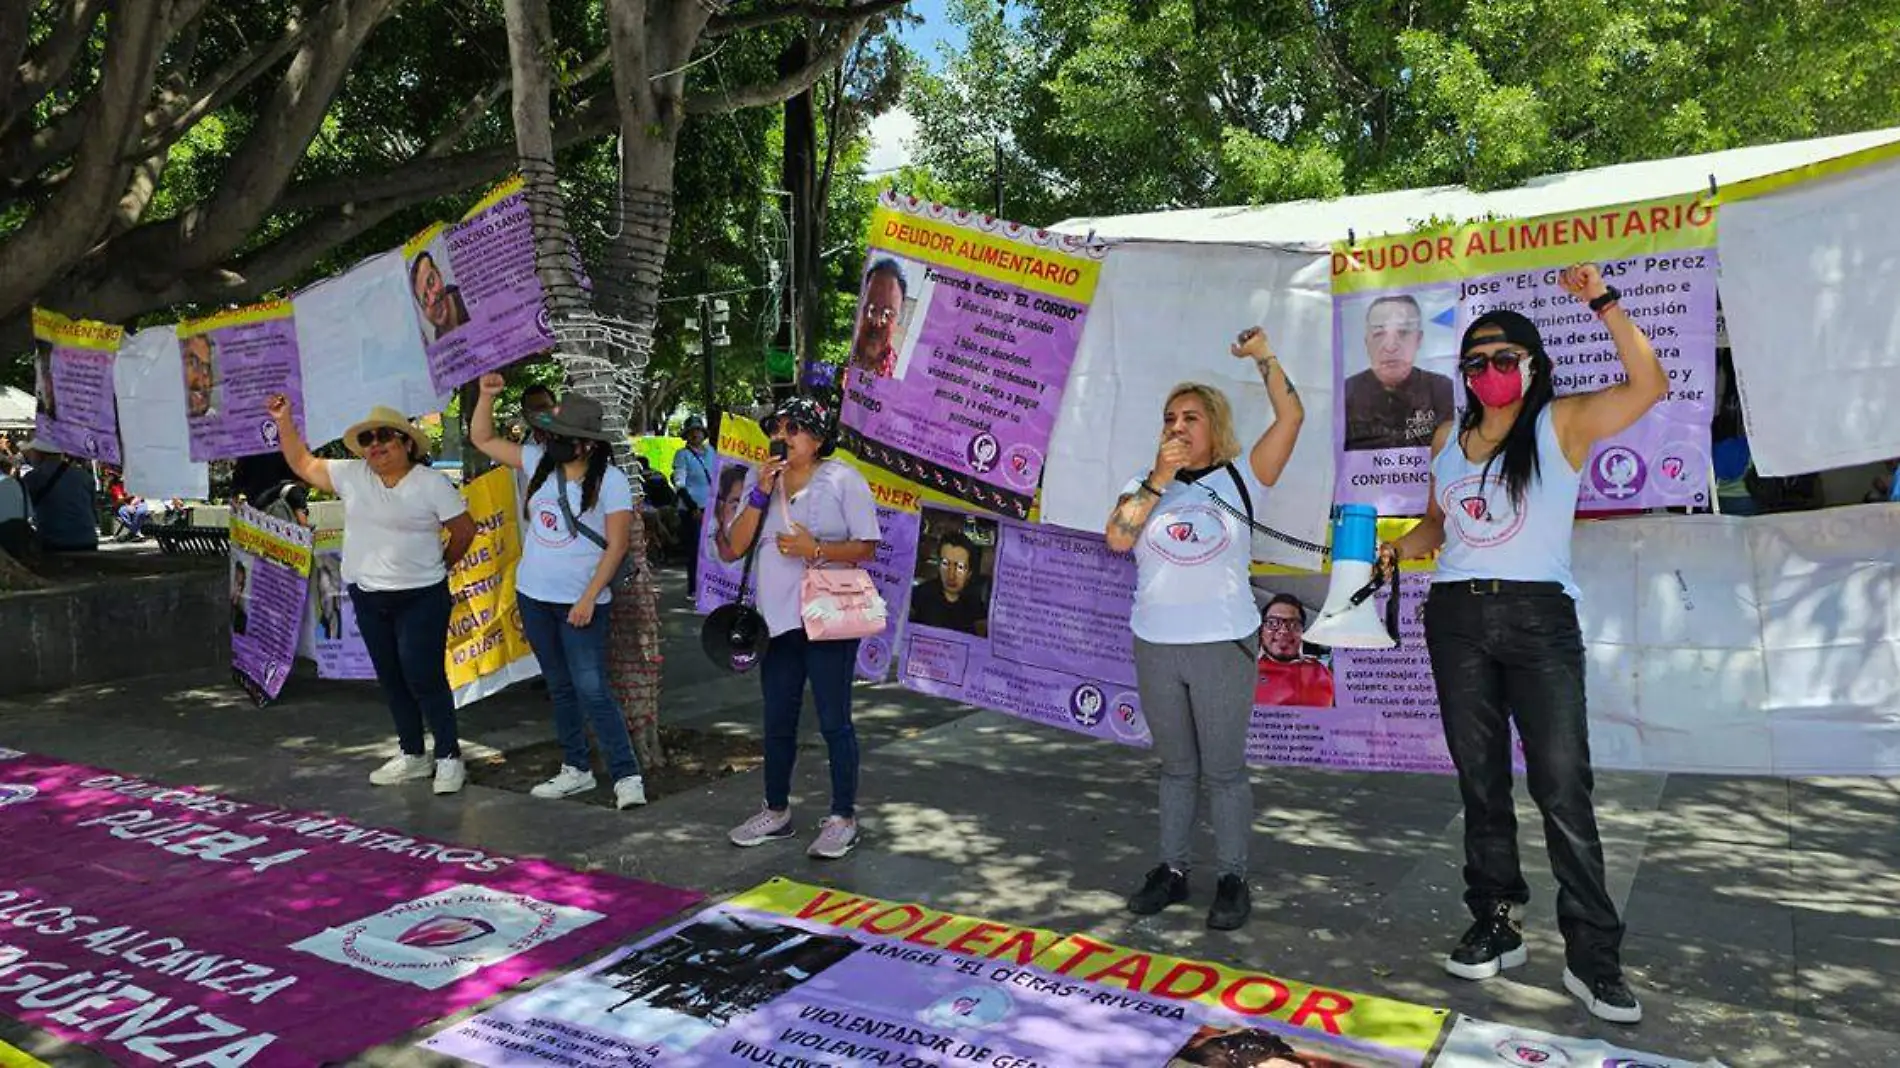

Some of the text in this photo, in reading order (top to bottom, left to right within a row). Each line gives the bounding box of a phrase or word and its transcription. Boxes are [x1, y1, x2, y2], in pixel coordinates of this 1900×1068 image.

[884, 219, 1080, 287] DEUDOR ALIMENTARIO
[1331, 200, 1714, 278] DEUDOR ALIMENTARIO
[1459, 279, 1501, 301] Jose
[1506, 274, 1539, 290] "EL
[1644, 254, 1706, 273] Perez
[1470, 304, 1486, 317] 12
[1529, 294, 1547, 309] de
[1556, 353, 1575, 366] su
[1566, 331, 1587, 345] de
[1351, 471, 1429, 486] CONFIDENC
[1373, 454, 1427, 468] No. Exp.
[68, 925, 299, 1005] ALCANZA
[795, 890, 1356, 1036] VIOLENTADOR
[866, 939, 944, 970] ANGEL
[953, 956, 987, 977] "EL
[1089, 990, 1187, 1022] RIVERA
[799, 1003, 955, 1053] VIOLENTADOR
[953, 1043, 994, 1063] DE
